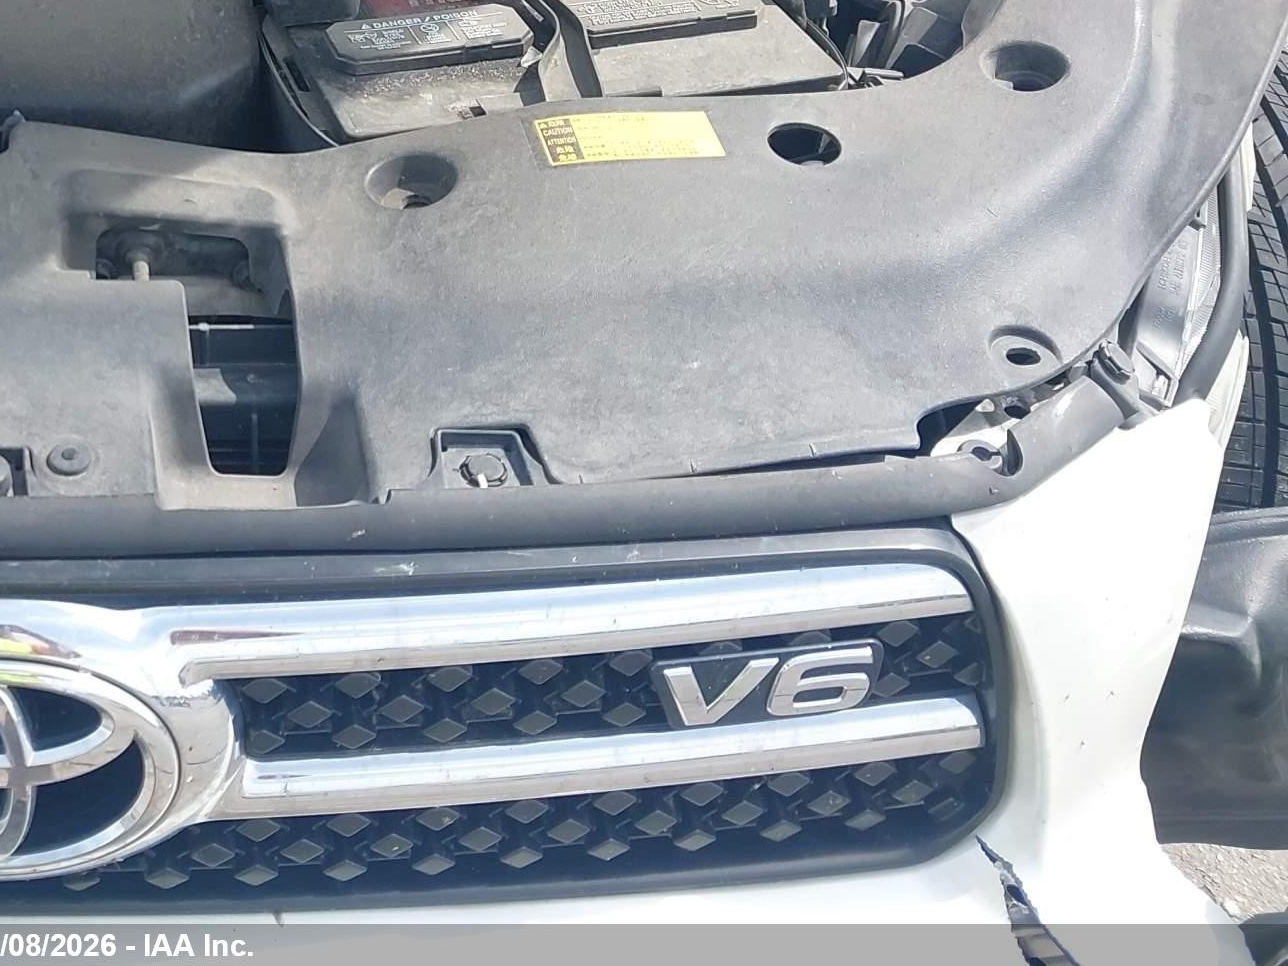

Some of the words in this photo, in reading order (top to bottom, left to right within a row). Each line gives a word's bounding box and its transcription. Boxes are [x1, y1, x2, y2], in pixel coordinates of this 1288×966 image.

[373, 17, 422, 29] DANGER
[543, 127, 574, 138] CAUTION
[663, 646, 873, 726] V6
